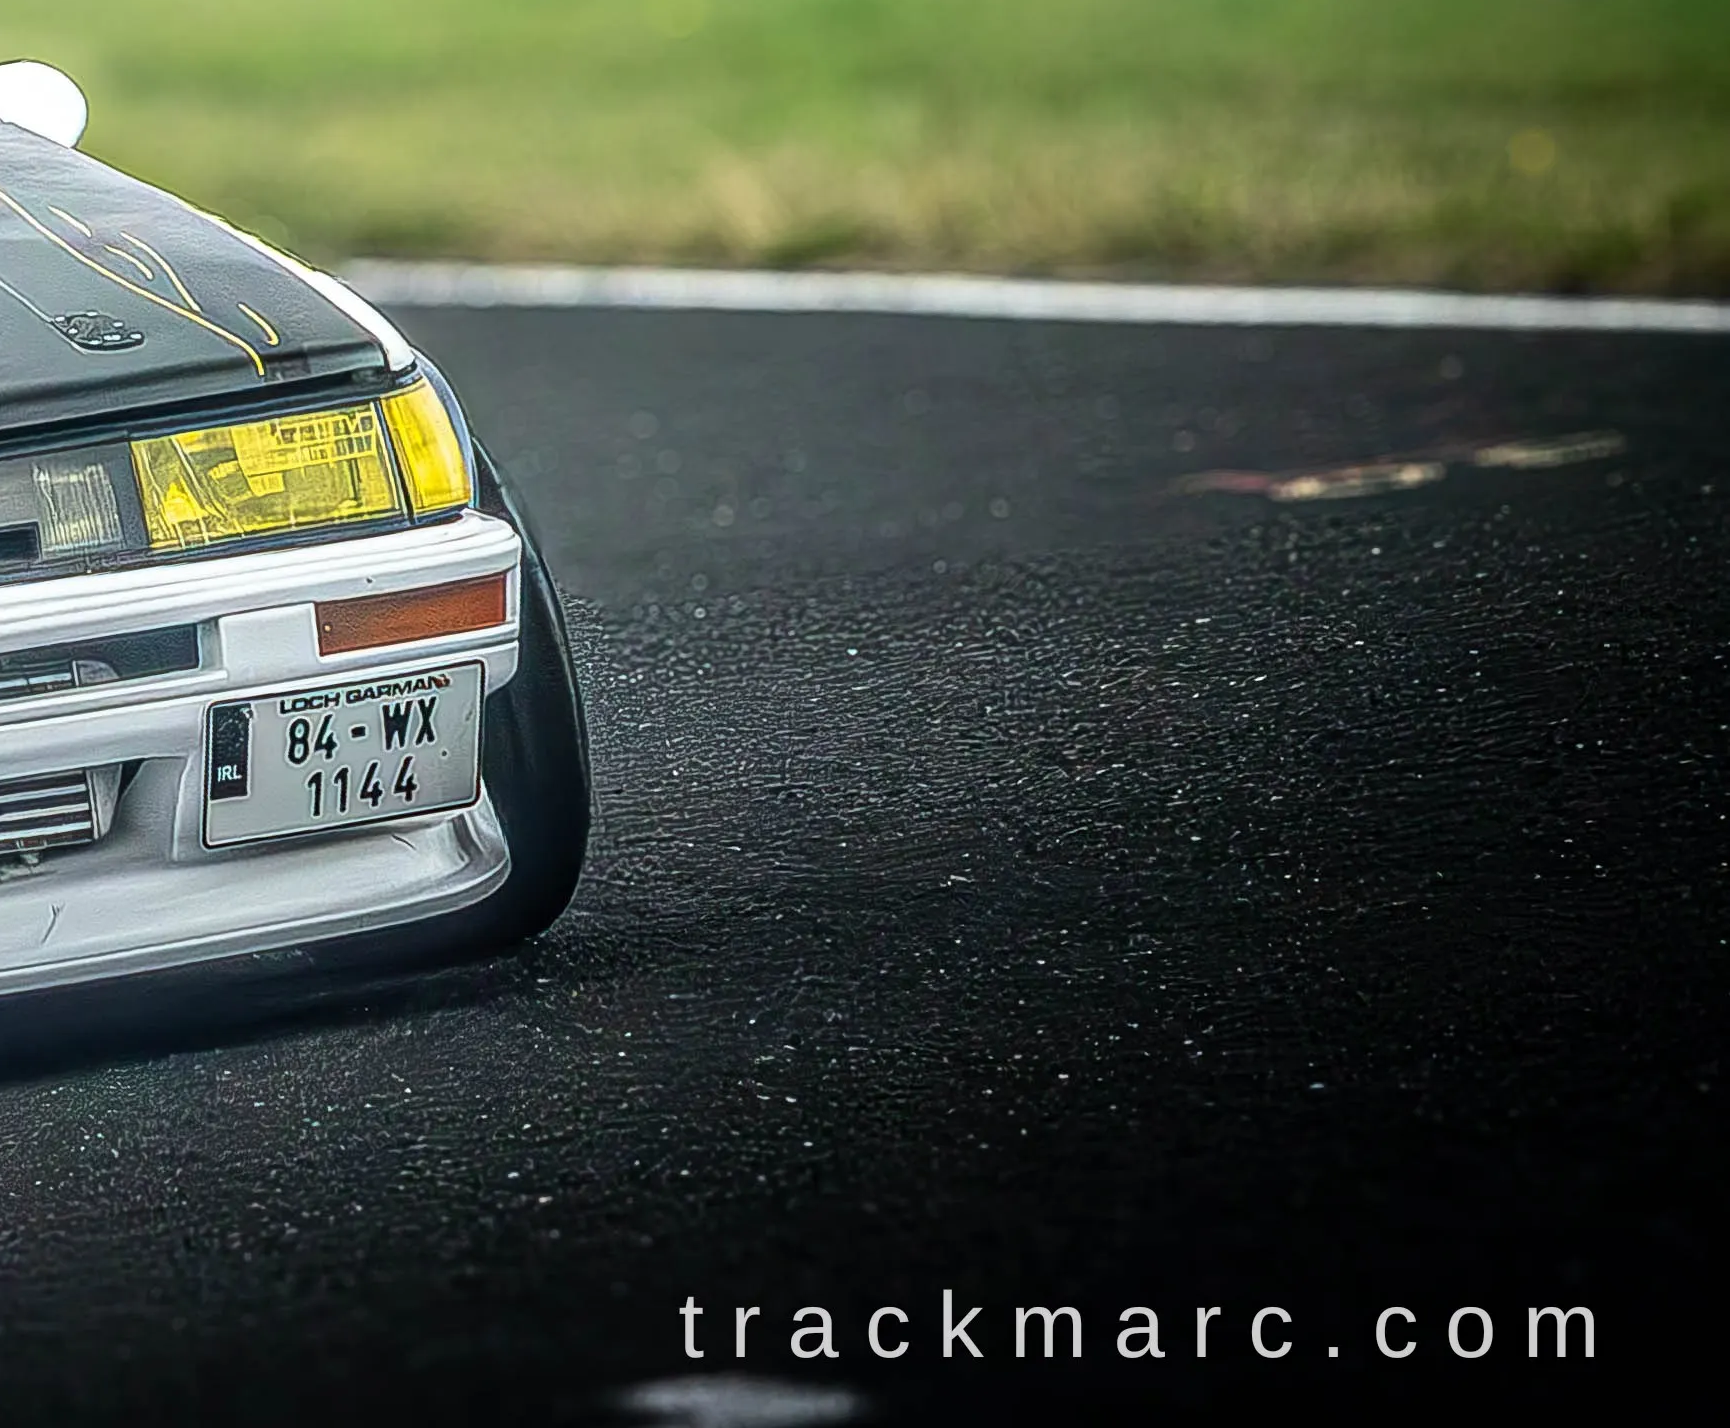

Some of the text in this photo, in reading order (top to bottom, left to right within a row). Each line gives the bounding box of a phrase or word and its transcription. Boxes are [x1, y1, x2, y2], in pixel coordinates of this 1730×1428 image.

[280, 692, 340, 714] LOCH
[217, 765, 242, 782] IRL
[307, 755, 418, 817] 1144
